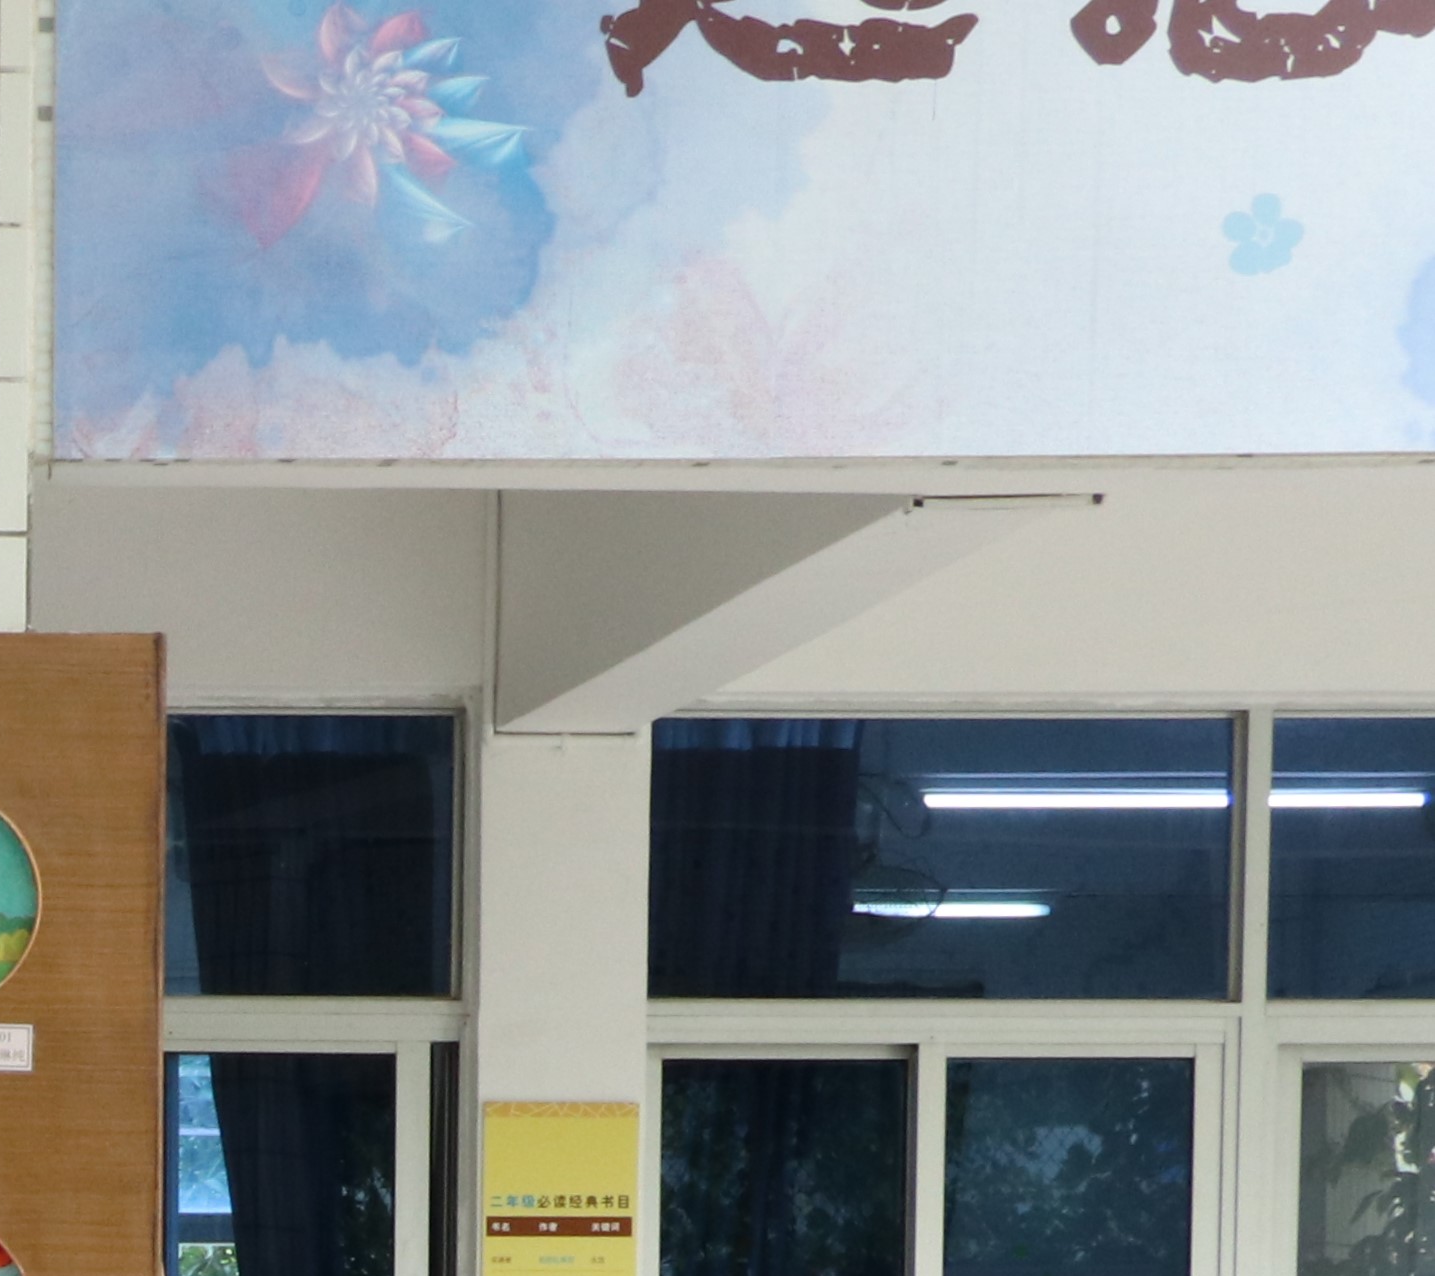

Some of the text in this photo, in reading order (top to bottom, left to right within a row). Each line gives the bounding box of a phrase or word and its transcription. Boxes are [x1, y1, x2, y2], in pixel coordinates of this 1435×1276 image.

[490, 1194, 630, 1209] 二年级必读经典书目
